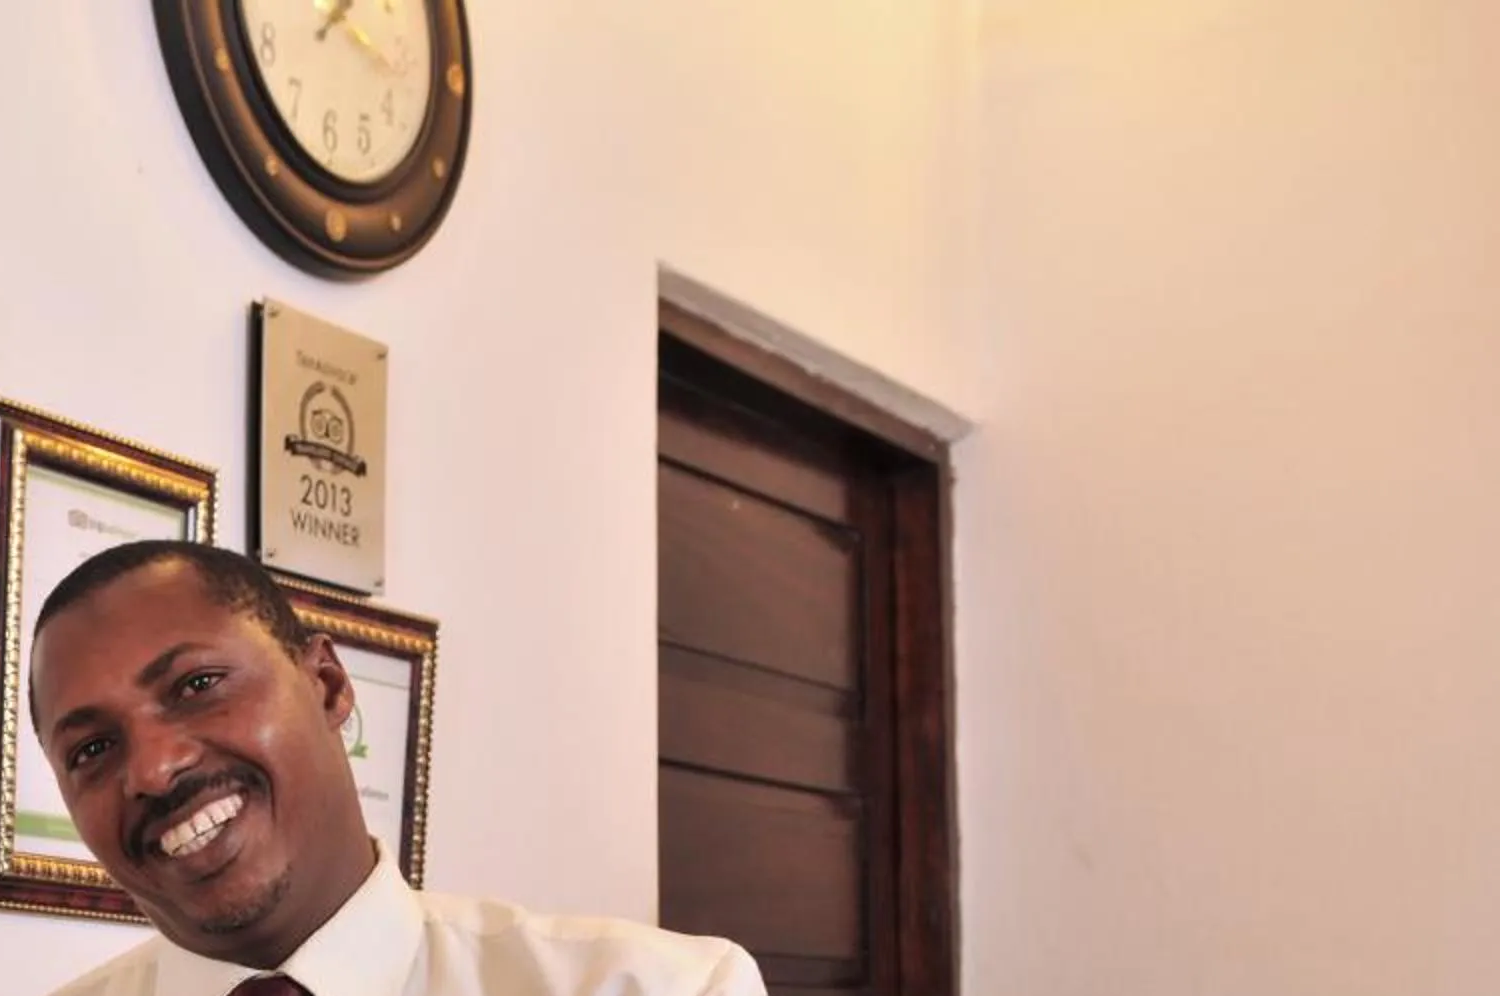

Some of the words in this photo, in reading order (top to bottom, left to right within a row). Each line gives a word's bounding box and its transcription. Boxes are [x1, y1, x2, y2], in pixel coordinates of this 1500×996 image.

[259, 22, 276, 67] 8
[288, 76, 303, 121] 7
[381, 88, 396, 126] 4
[322, 109, 338, 154] 6
[357, 112, 372, 155] 5
[300, 474, 353, 518] 2013
[290, 507, 361, 549] WINNER
